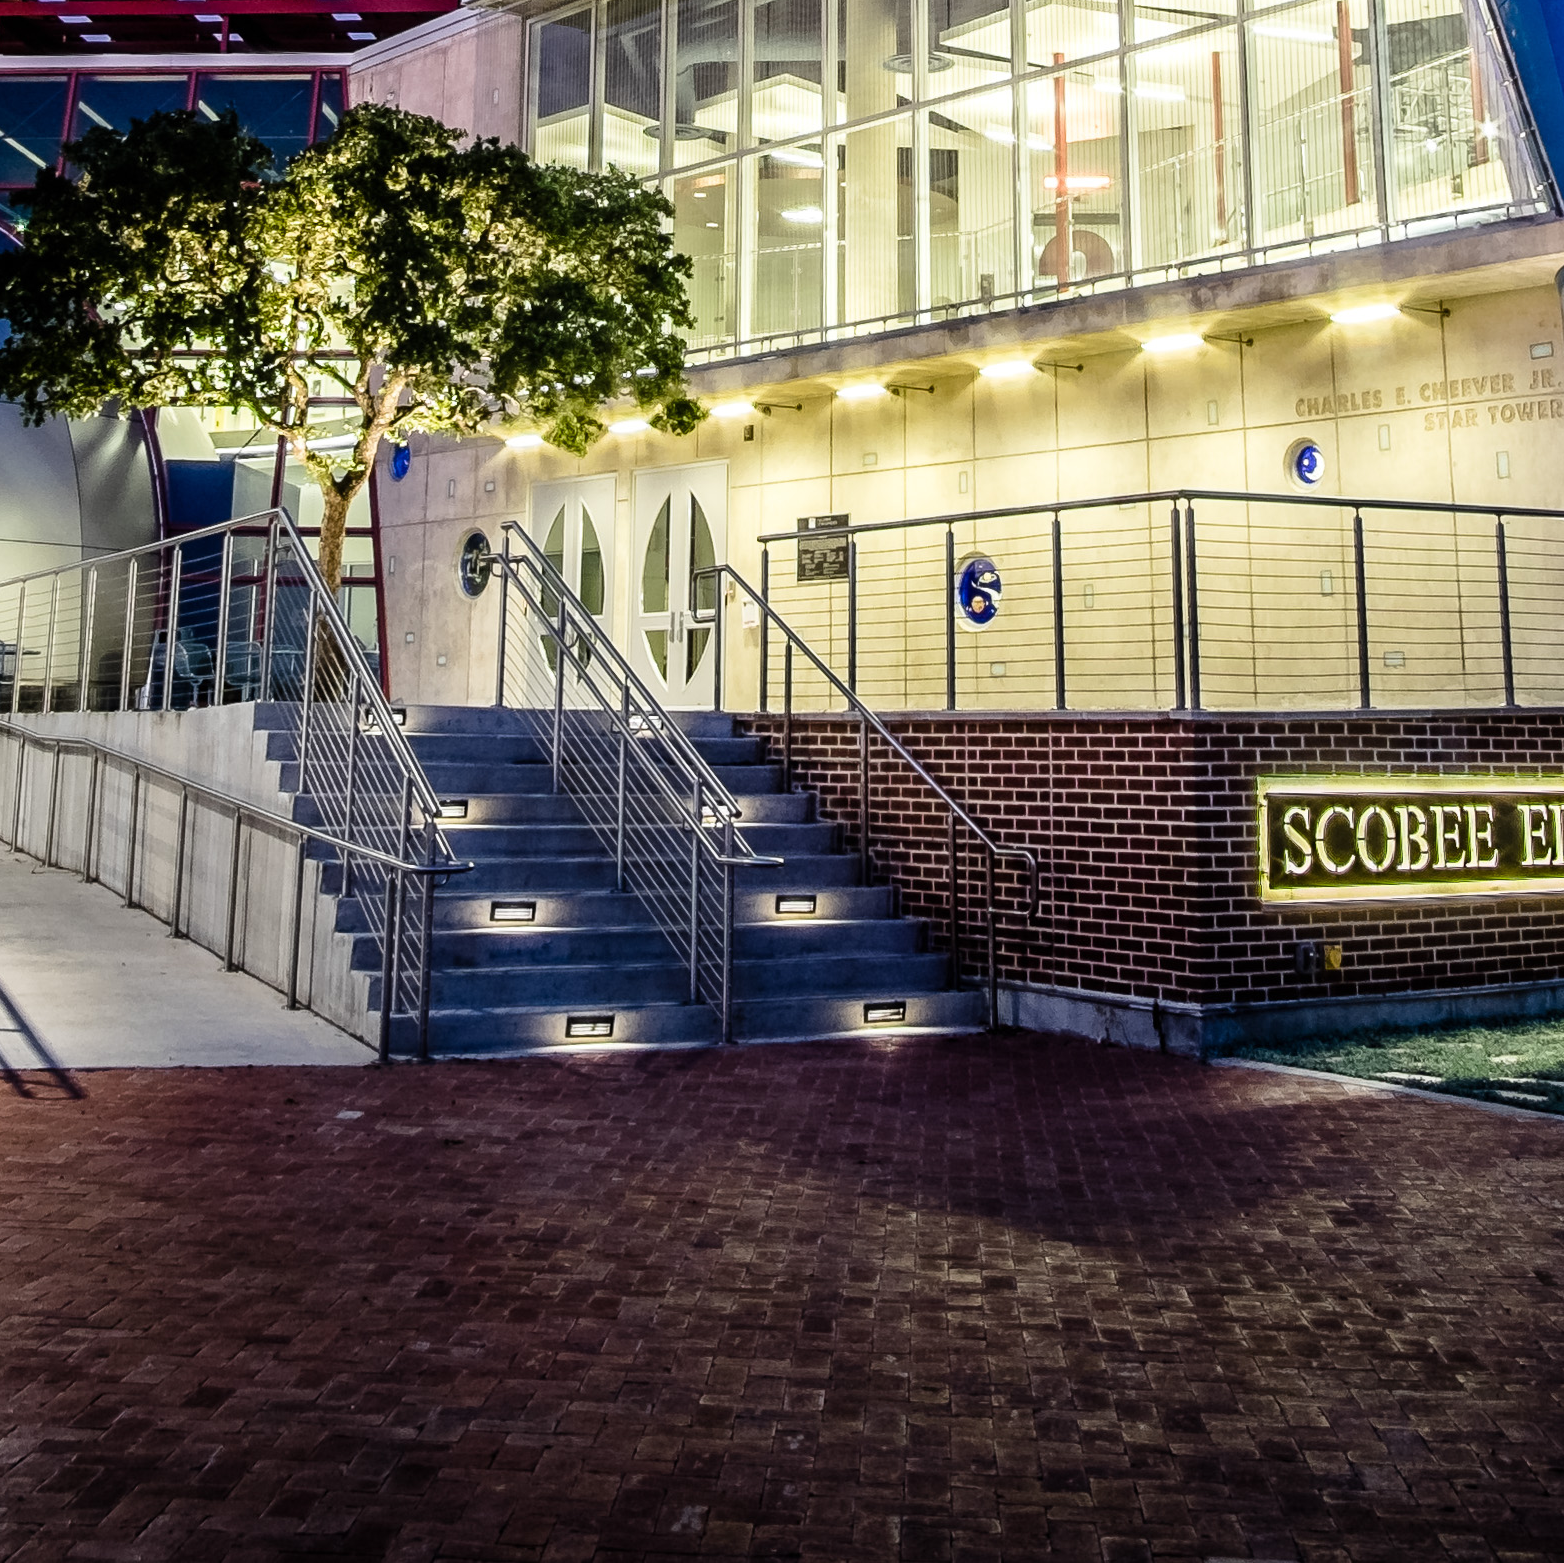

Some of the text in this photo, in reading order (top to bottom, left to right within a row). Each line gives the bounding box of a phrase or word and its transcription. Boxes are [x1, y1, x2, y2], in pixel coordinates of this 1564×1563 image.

[1295, 368, 1563, 417] CHARLES E. CHEEVER JR.
[1424, 399, 1564, 432] STAR TOWER
[1283, 804, 1499, 875] SCOBEE
